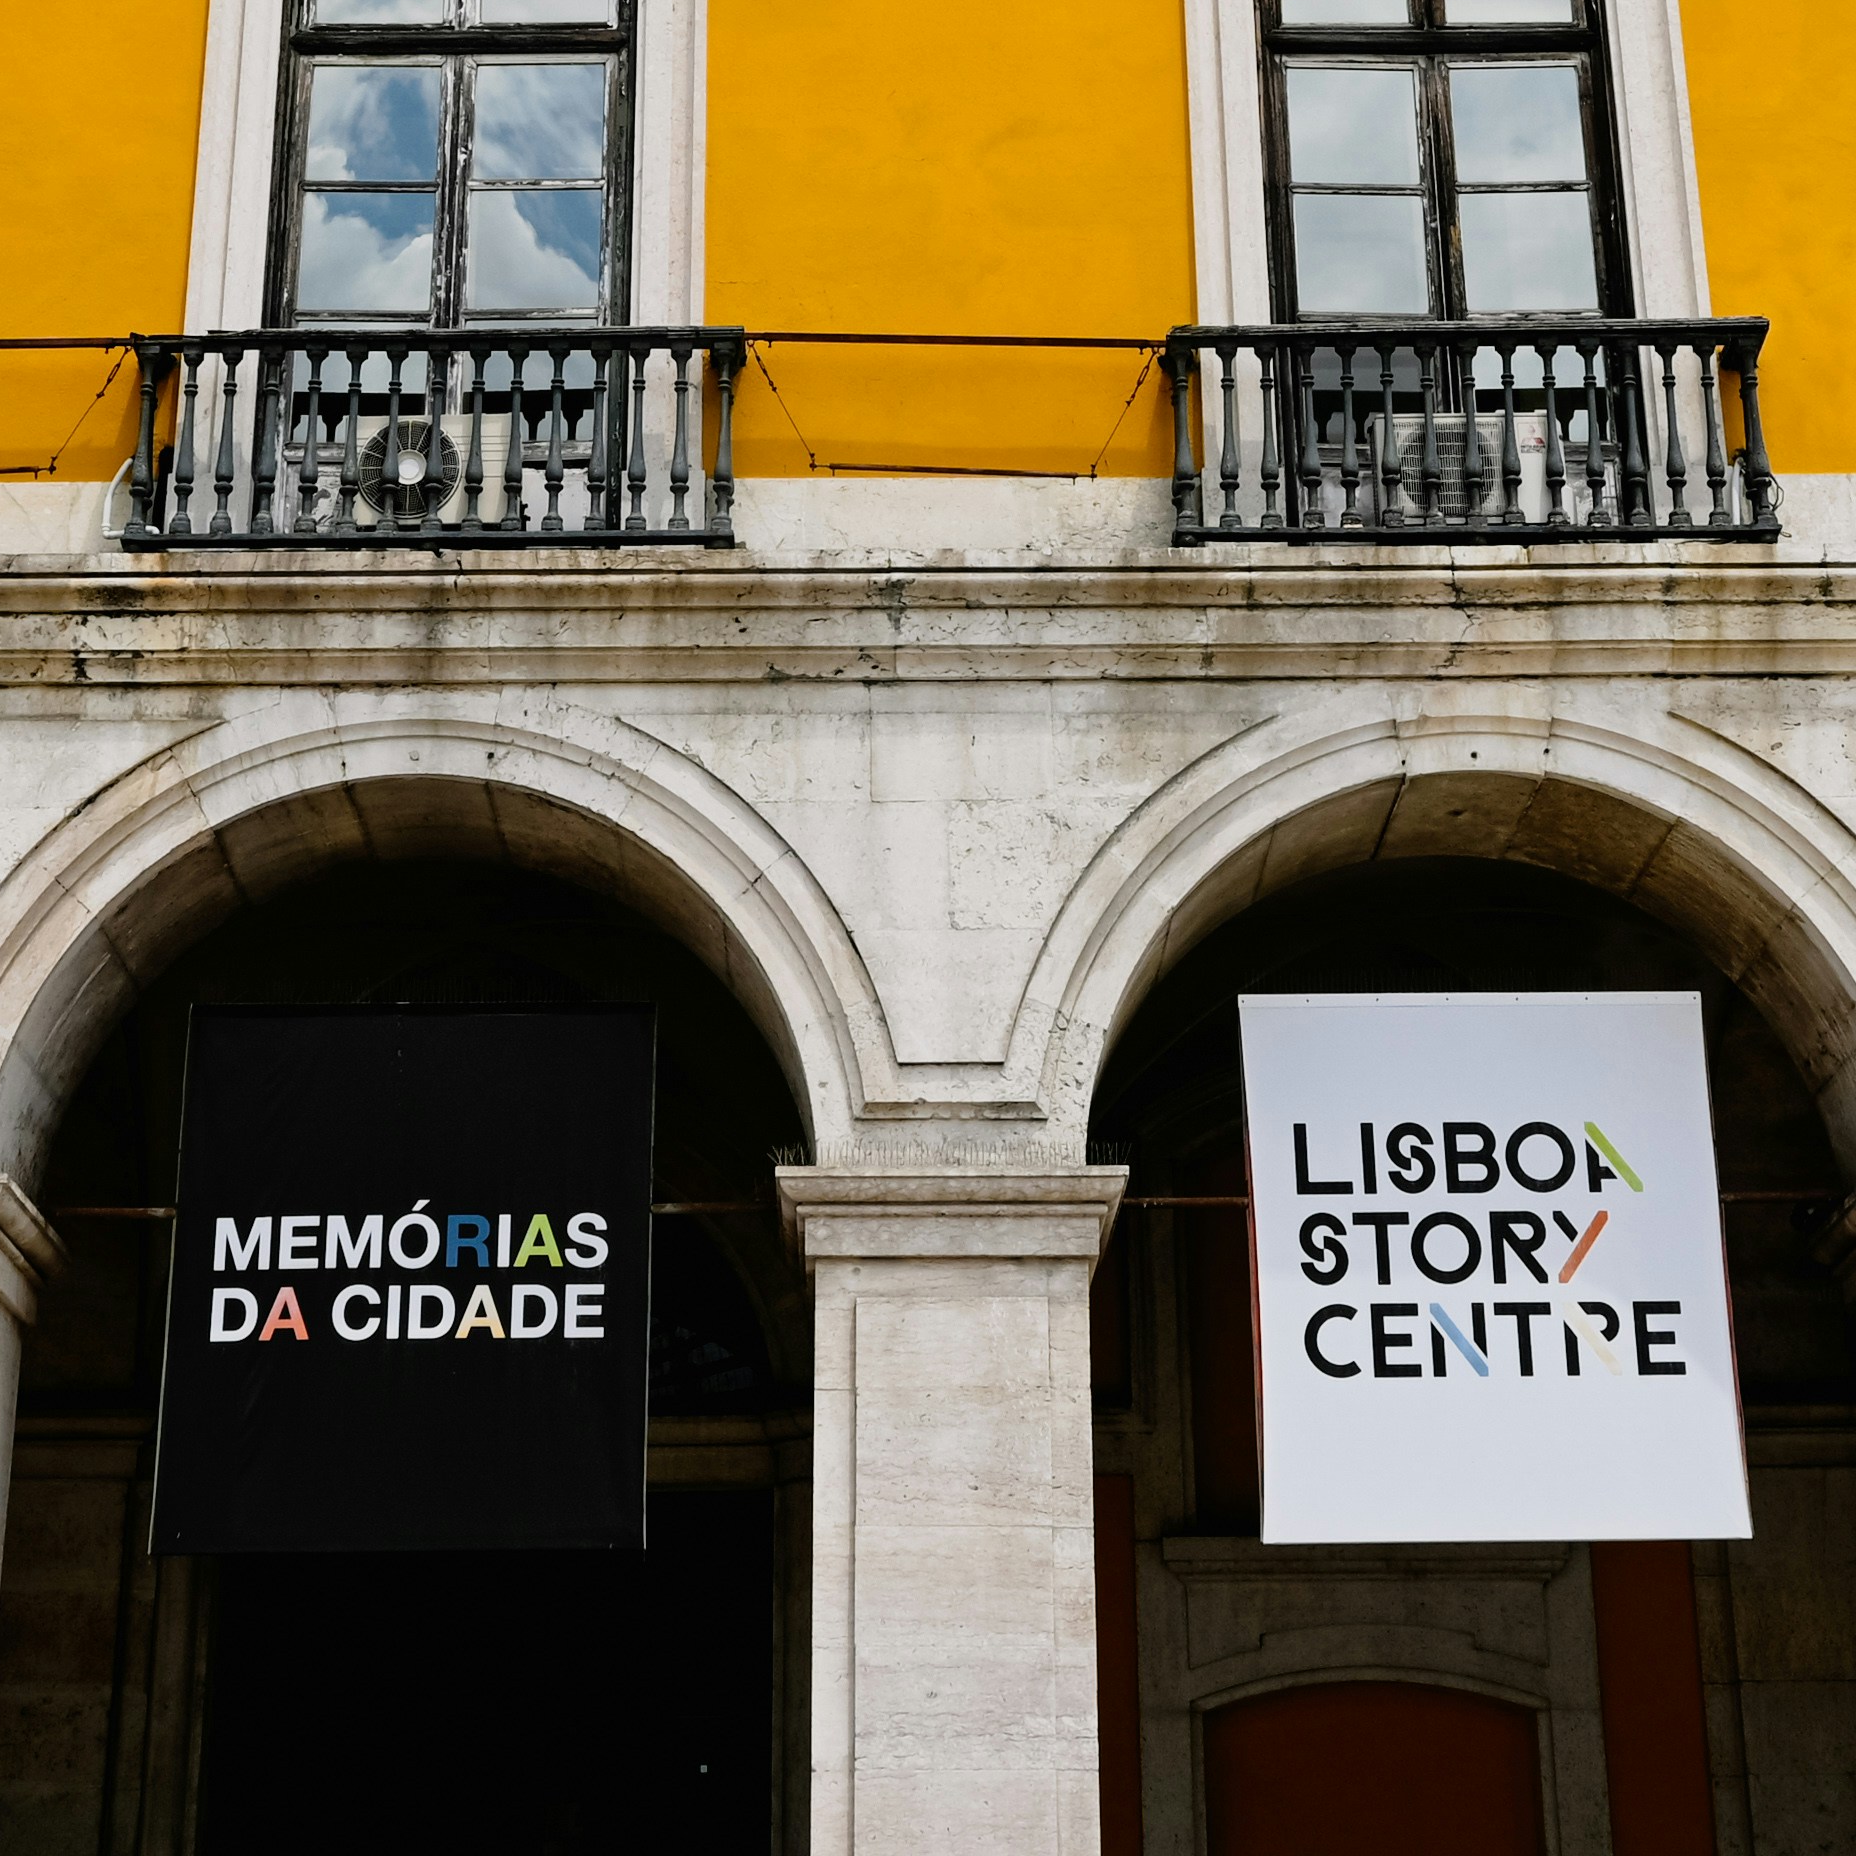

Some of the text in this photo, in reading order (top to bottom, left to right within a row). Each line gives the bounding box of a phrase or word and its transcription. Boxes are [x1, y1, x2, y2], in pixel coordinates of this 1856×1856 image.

[1292, 1121, 1644, 1196] LISBOA
[213, 1199, 609, 1272] MEMÓRIAS
[1298, 1210, 1609, 1286] STORY
[209, 1283, 605, 1343] DA CIDADE
[1303, 1301, 1687, 1378] CENTRE
